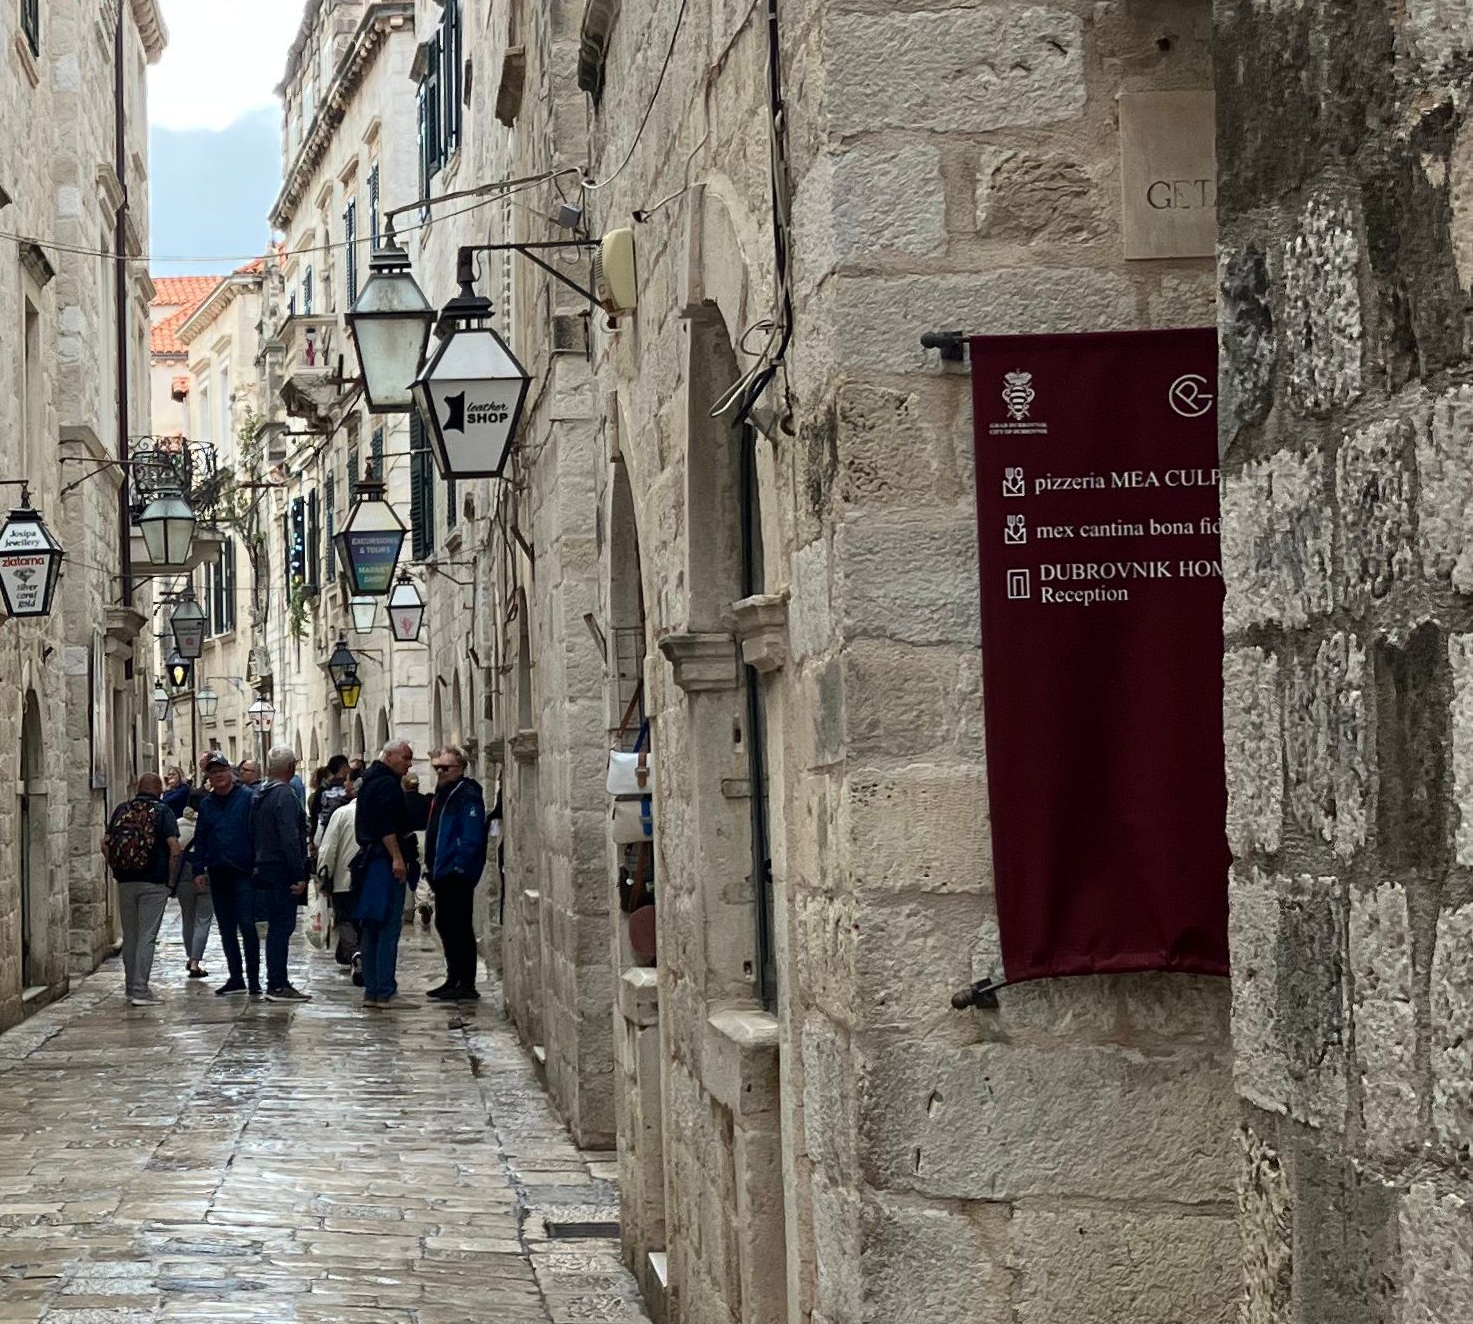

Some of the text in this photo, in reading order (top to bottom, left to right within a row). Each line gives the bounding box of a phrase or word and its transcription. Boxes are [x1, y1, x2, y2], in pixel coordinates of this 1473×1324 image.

[1147, 179, 1217, 210] GET
[467, 401, 508, 411] leather
[467, 413, 508, 424] SHOP
[1035, 473, 1105, 494] pizzeria
[1111, 471, 1160, 488] MEA
[1037, 526, 1074, 538] mex
[1080, 519, 1144, 537] cantina
[1150, 519, 1194, 535] bona
[2, 557, 44, 567] zlatarna
[1040, 561, 1173, 581] DUBROVNIK
[1041, 585, 1129, 606] Reception
